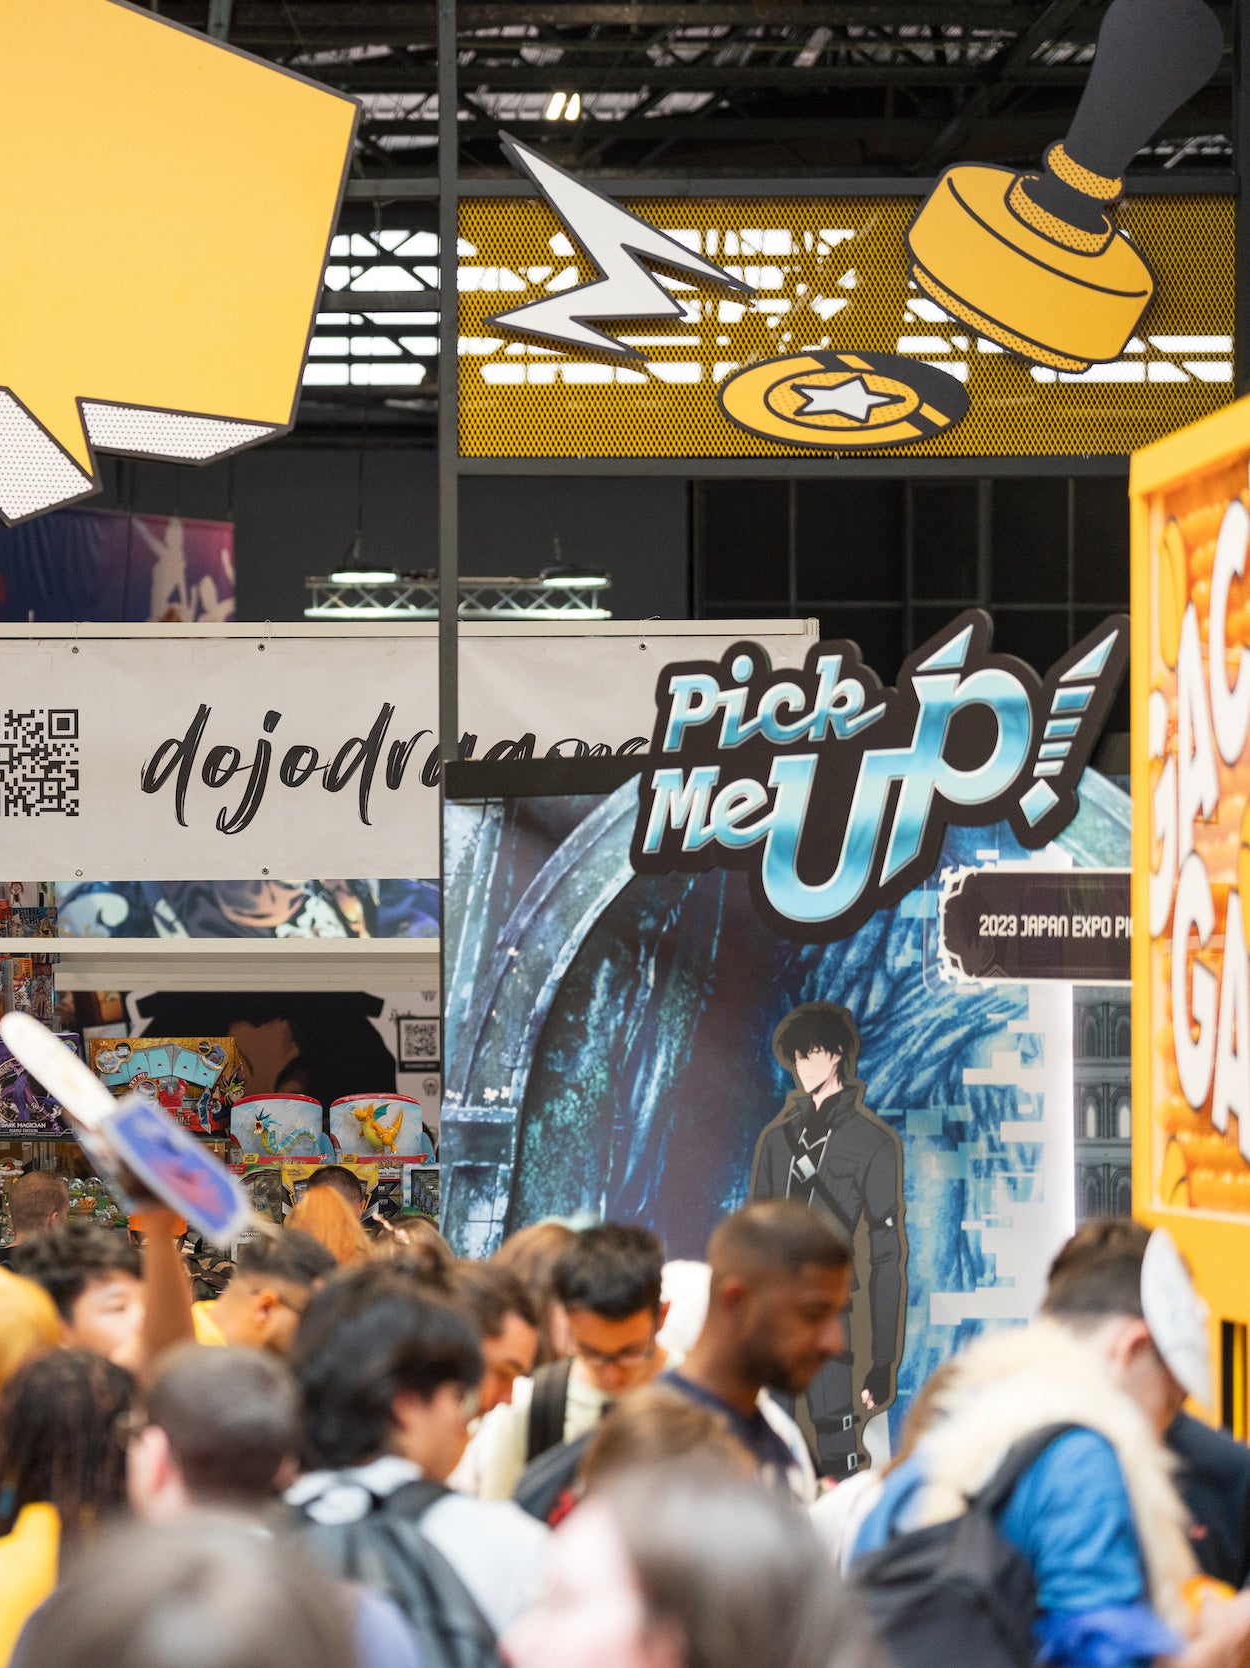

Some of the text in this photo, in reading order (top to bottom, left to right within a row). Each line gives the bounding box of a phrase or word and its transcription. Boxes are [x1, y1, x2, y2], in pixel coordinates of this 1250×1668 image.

[666, 655, 886, 752] Pick
[643, 765, 772, 853] Me
[979, 914, 1018, 937] 2023
[1020, 915, 1069, 938] JAPAN
[1071, 915, 1112, 938] EXPO
